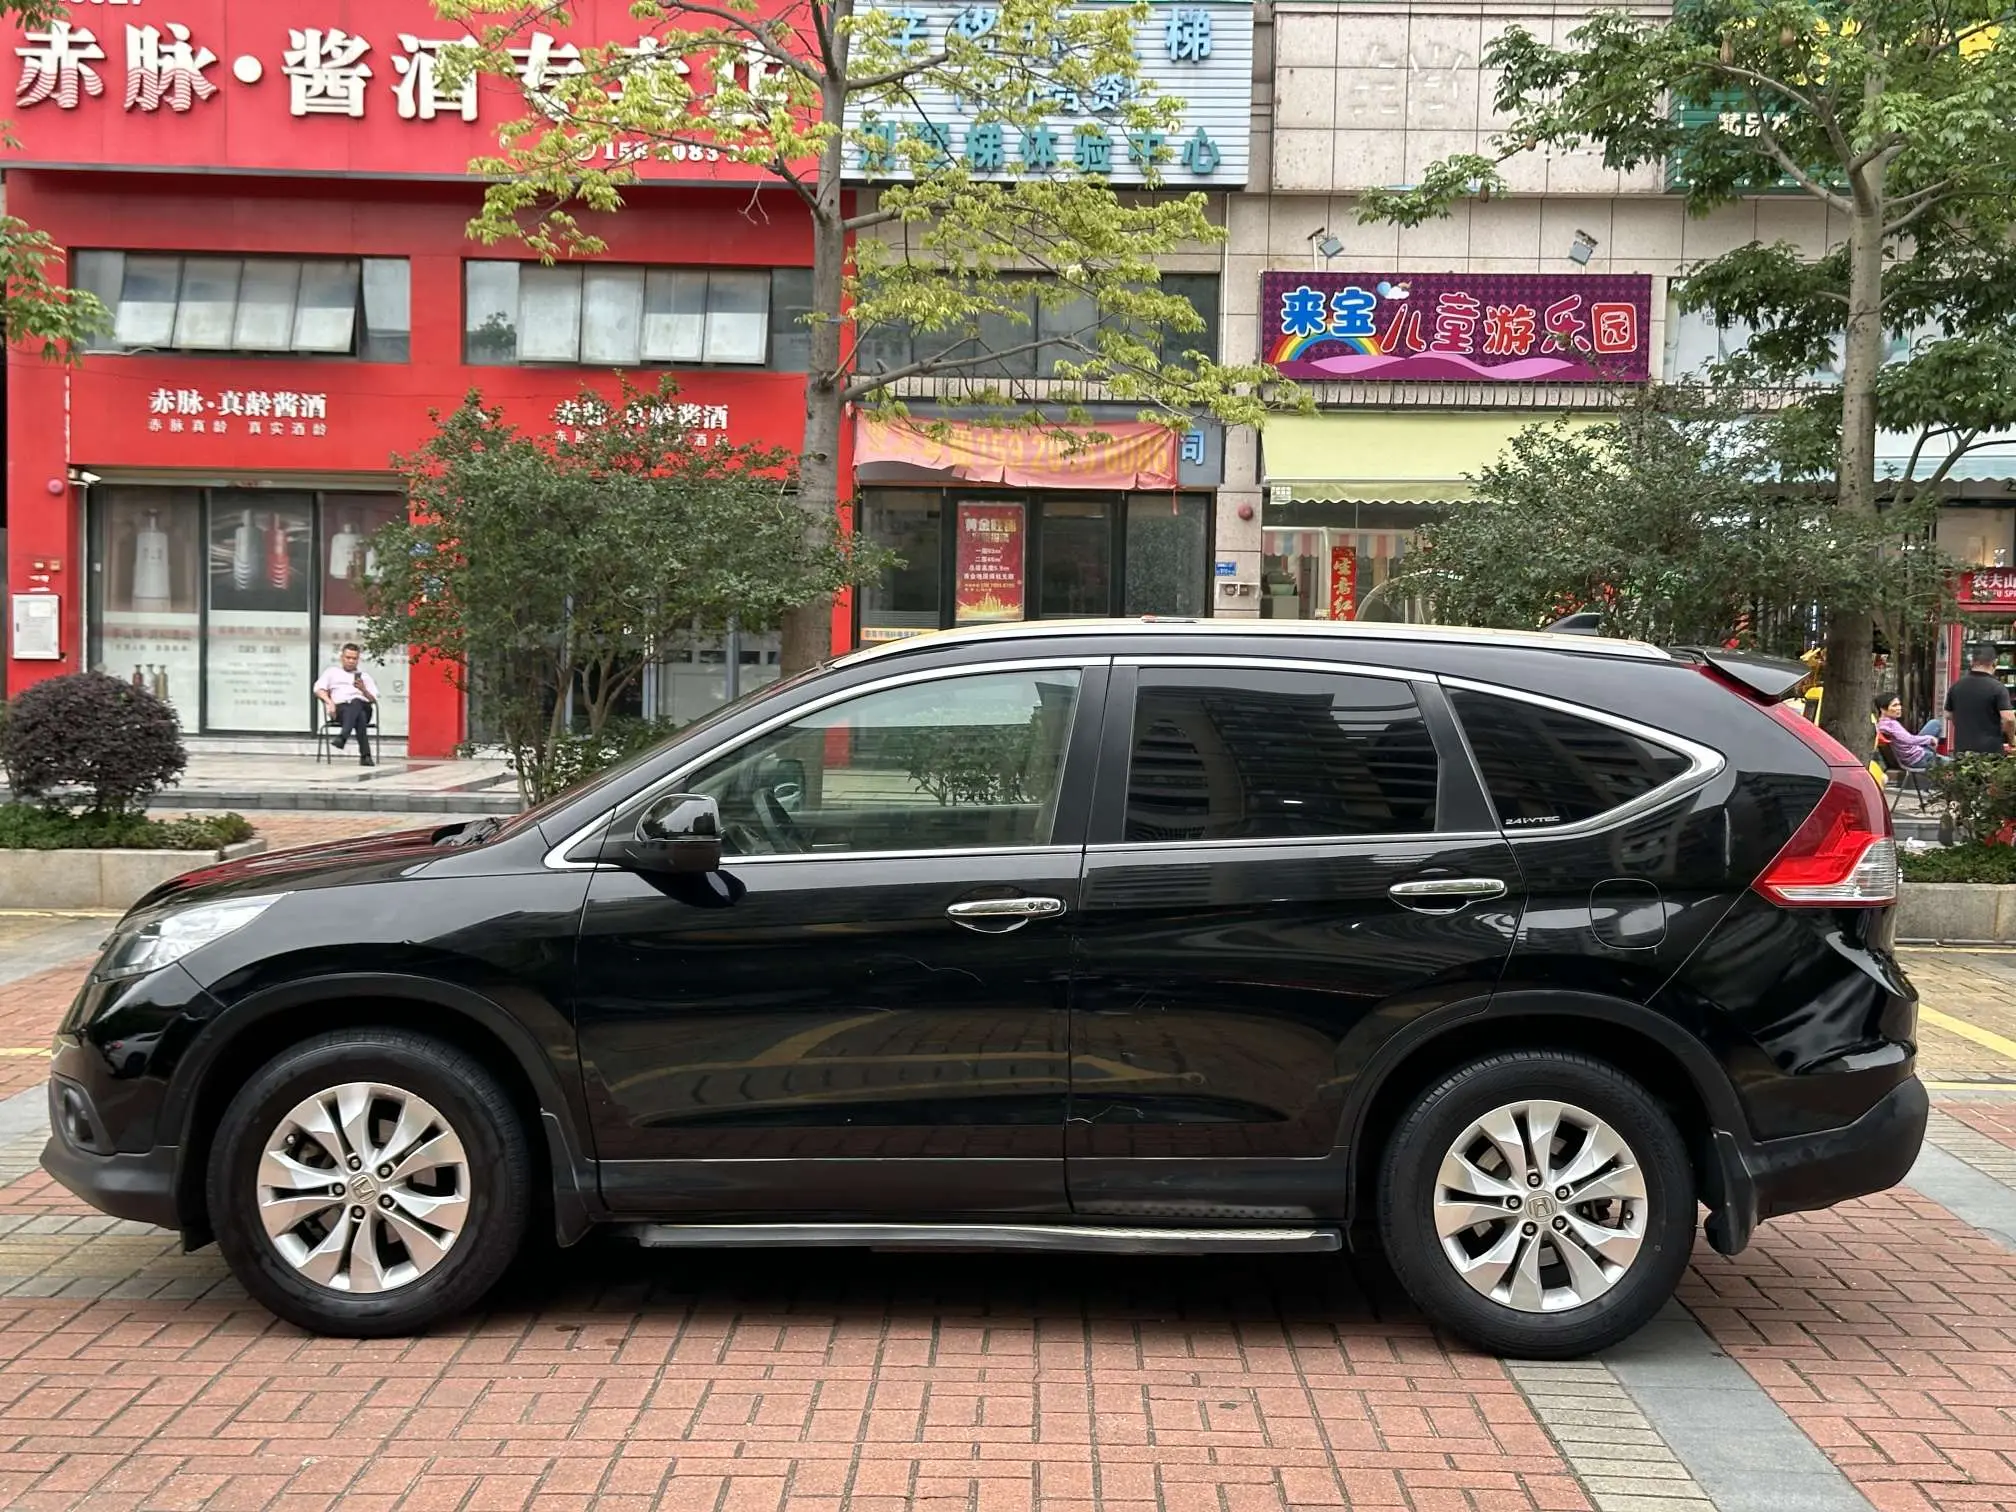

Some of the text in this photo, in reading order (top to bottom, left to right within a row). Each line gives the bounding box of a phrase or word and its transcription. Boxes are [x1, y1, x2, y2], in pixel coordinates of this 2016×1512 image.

[1281, 286, 1638, 355] 来宝儿童游乐园
[149, 387, 327, 419] 赤脉·真龄酱酒
